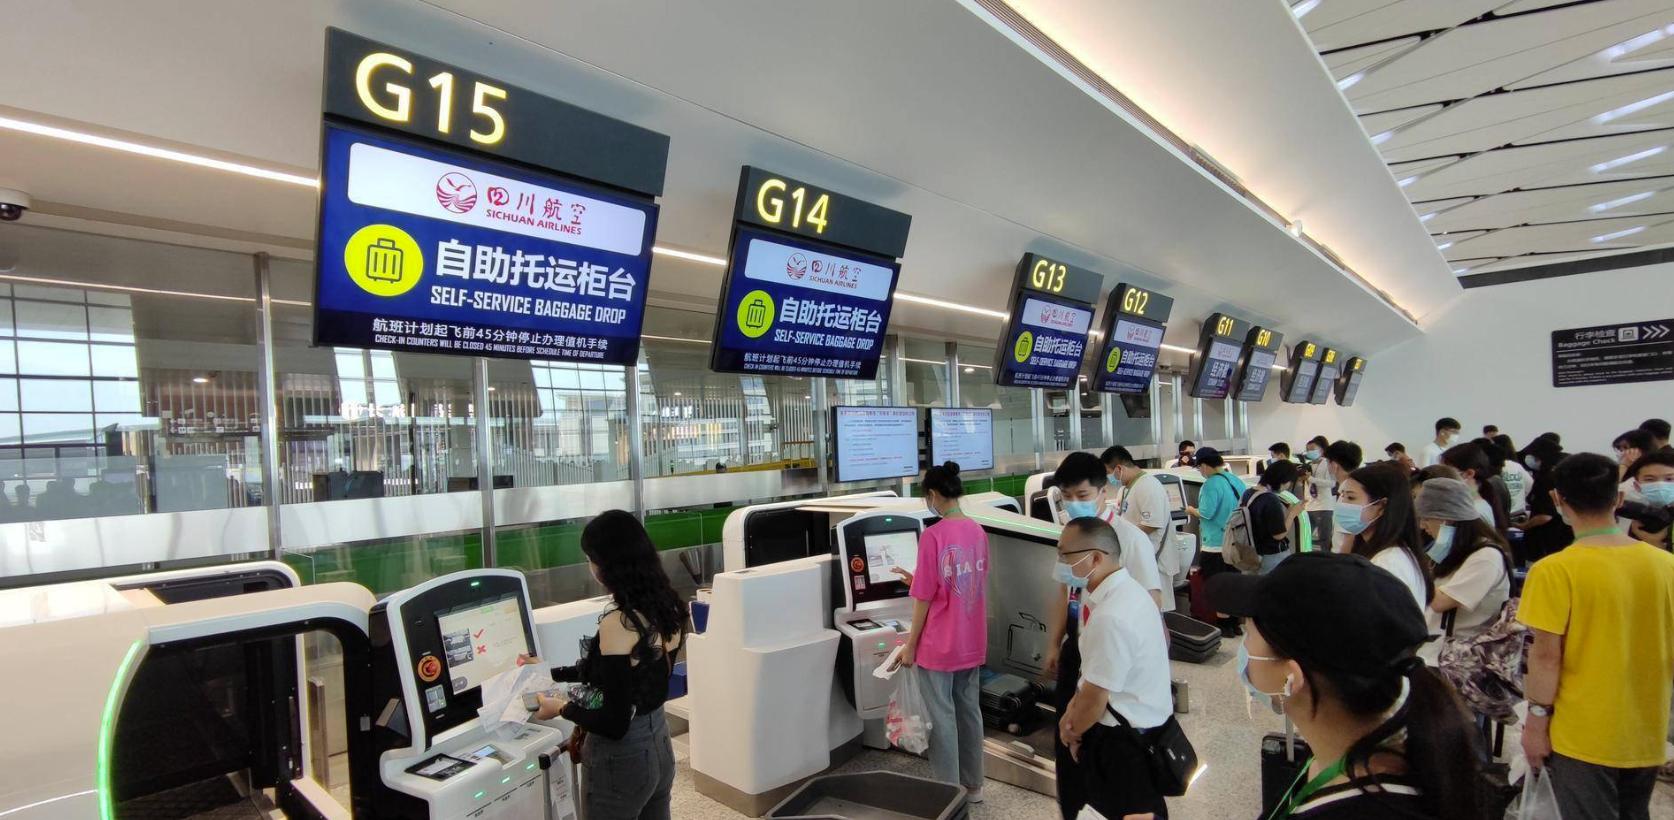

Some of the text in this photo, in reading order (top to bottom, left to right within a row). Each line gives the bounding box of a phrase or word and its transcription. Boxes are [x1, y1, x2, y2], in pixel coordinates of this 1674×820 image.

[355, 52, 508, 144] G15
[487, 186, 586, 225] 四川航空
[757, 178, 830, 234] G14
[486, 209, 582, 235] SICHUAN AIRLINES
[436, 238, 636, 301] 自助托运柜台
[811, 259, 862, 283] 四川航空
[1032, 259, 1067, 293] G13
[430, 286, 626, 325] SELF-SERVICE BAGGAGE DROP
[780, 297, 882, 334] 自助托运柜台
[1124, 288, 1149, 315] G12
[372, 317, 609, 350] 航班计划起飞前45分钟停止办理值机手续
[774, 329, 874, 350] SELF-SERVICE BAGGAGE DROP
[1217, 316, 1234, 337] G11
[1257, 329, 1272, 347] G10
[374, 334, 405, 345] CHECK-IN
[406, 336, 438, 347] COUNTERS
[439, 339, 453, 348] WILL
[454, 340, 461, 349] BE
[462, 341, 484, 351] CLOSED
[485, 342, 493, 351] 45
[493, 344, 516, 353] MINUTES
[516, 345, 535, 354] BEFORE
[1558, 340, 1591, 349] Baggage
